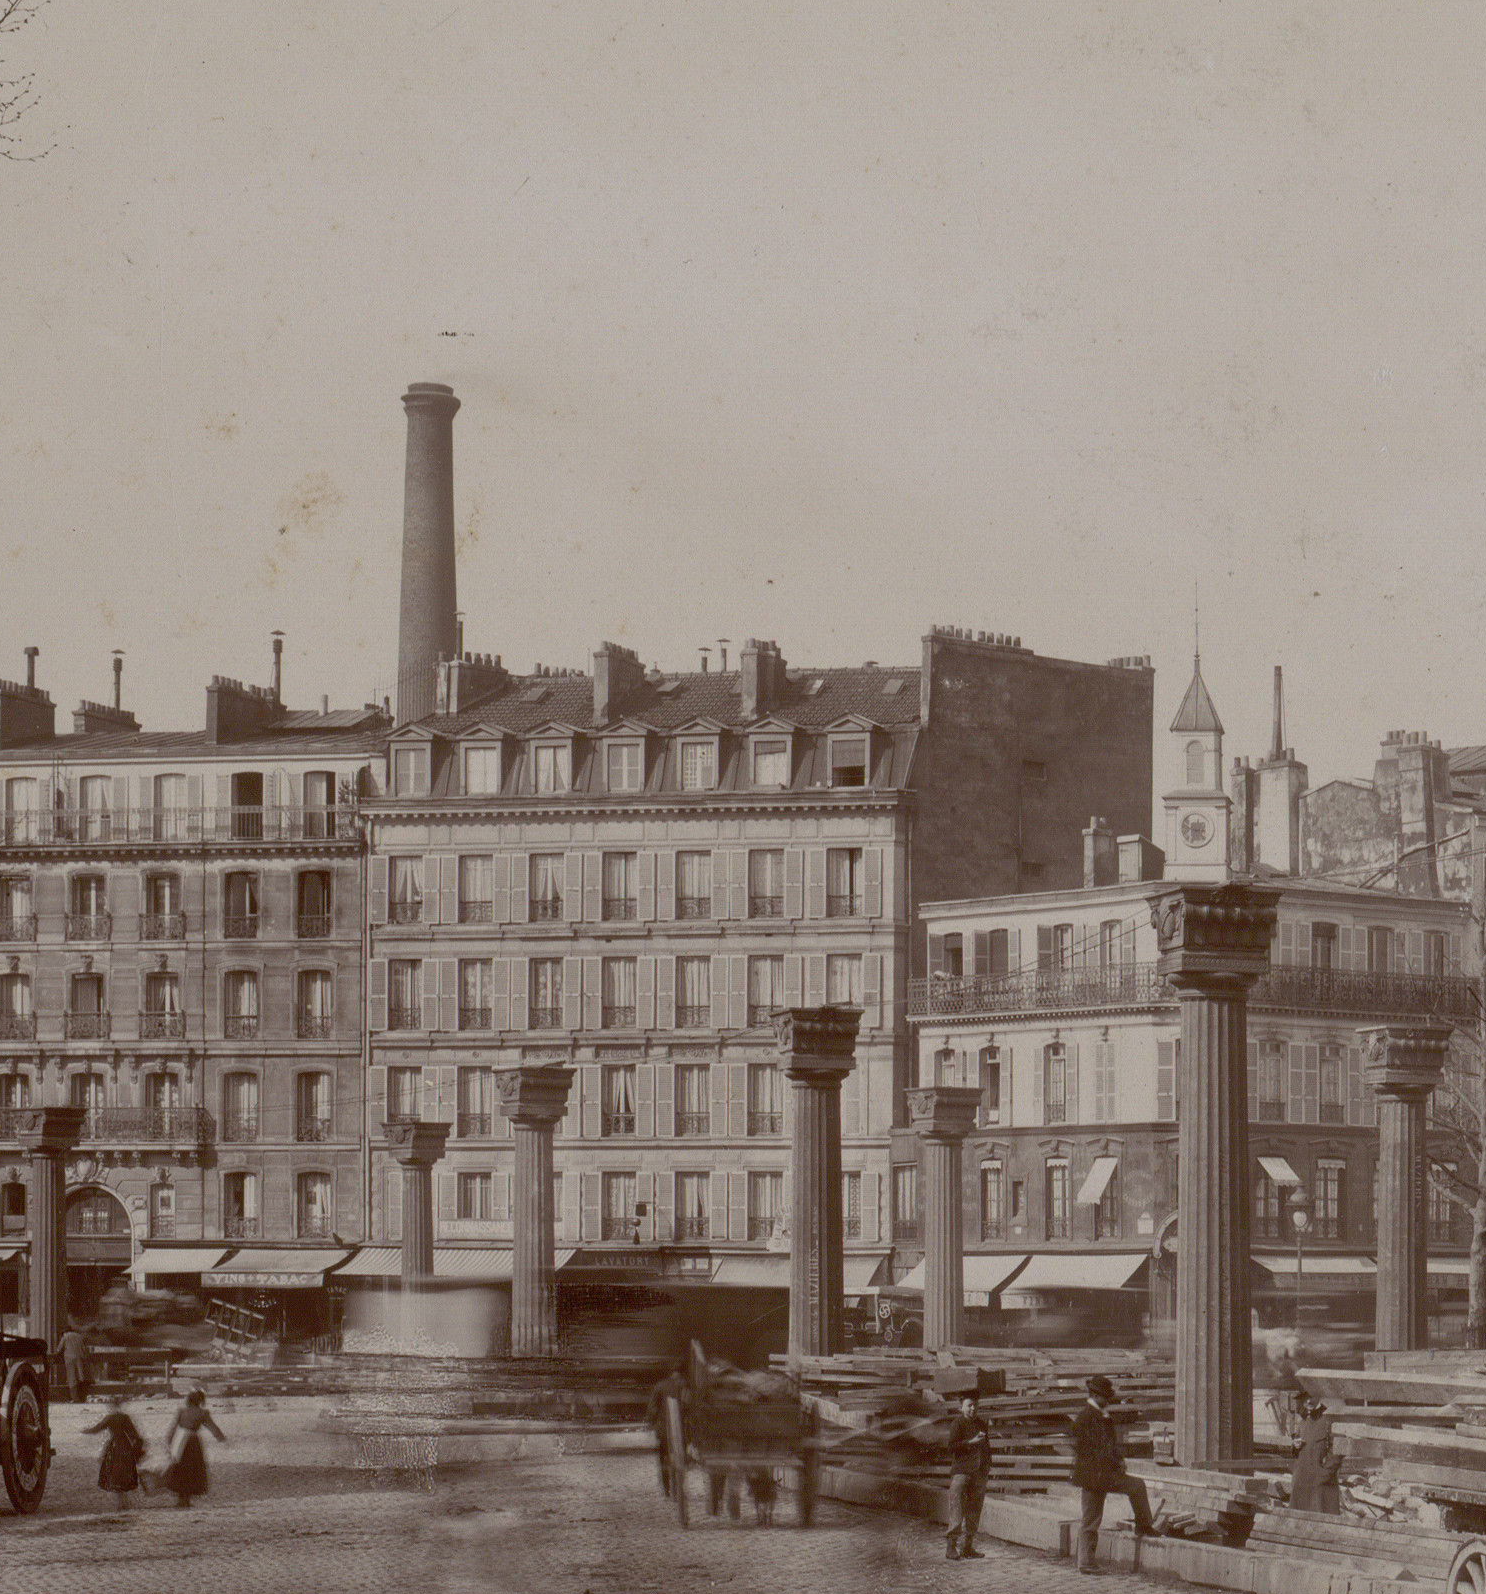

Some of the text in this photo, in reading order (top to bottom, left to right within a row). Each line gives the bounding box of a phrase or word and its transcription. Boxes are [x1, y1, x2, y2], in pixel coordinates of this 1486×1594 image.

[595, 1256, 650, 1266] LAVATORY
[214, 1274, 308, 1285] VINS TABAC
